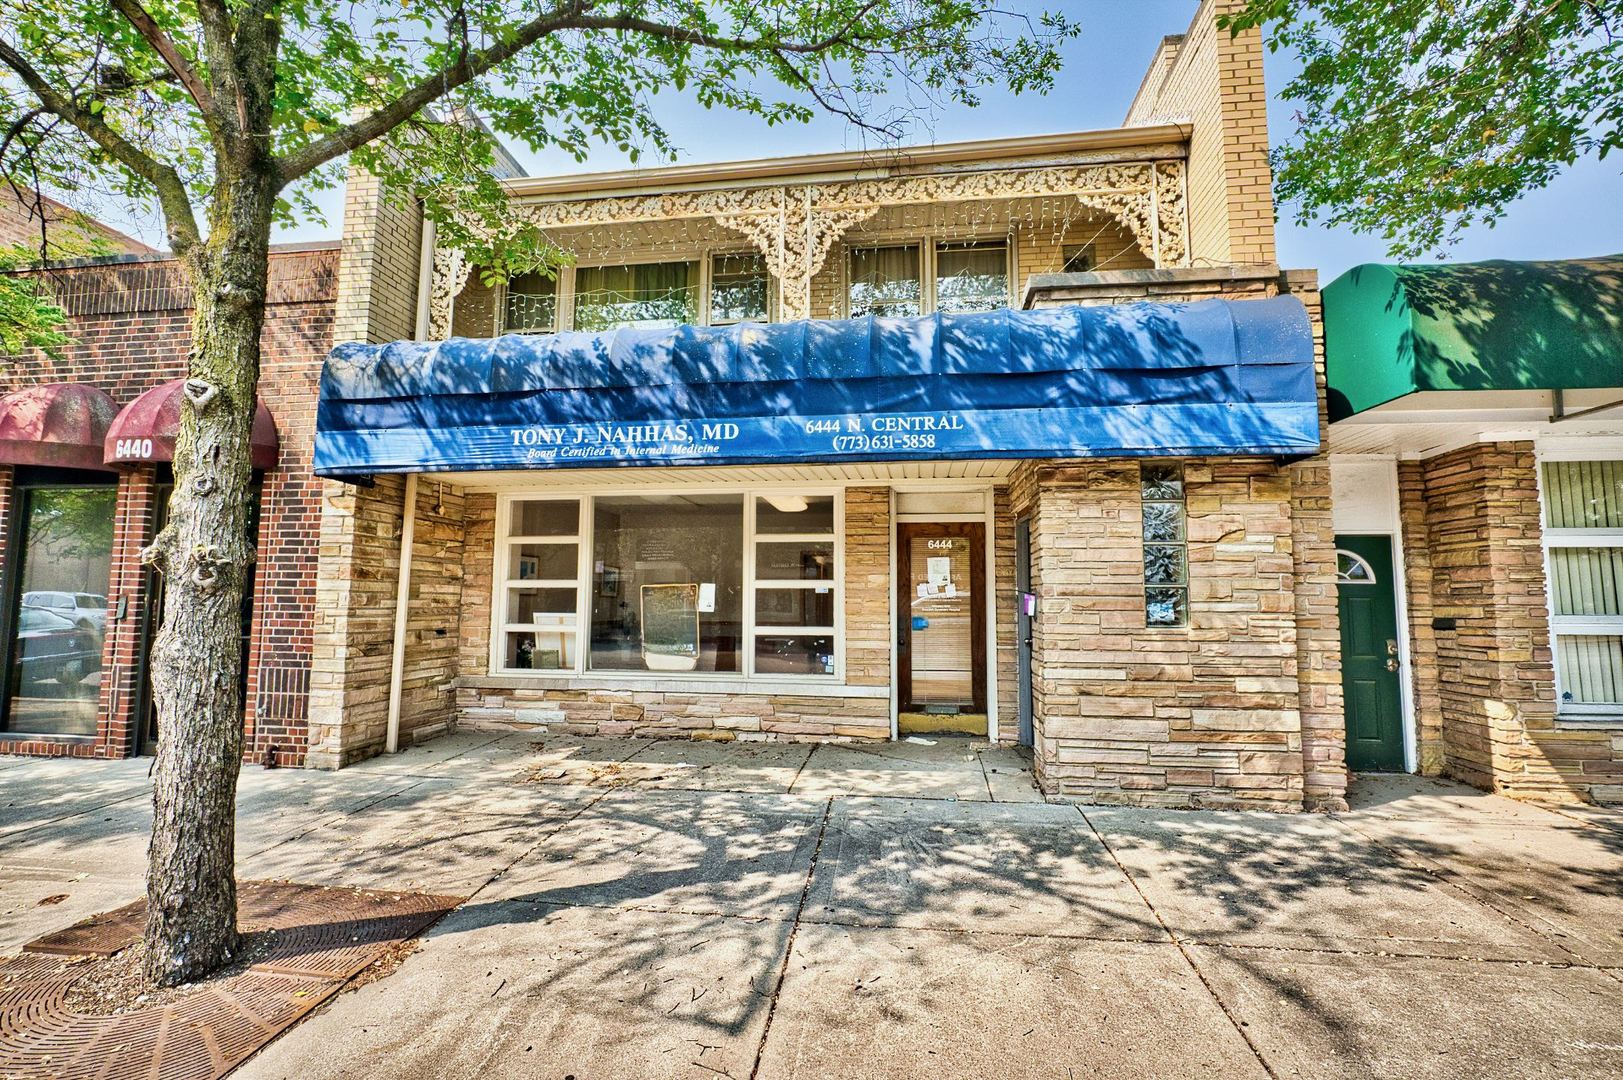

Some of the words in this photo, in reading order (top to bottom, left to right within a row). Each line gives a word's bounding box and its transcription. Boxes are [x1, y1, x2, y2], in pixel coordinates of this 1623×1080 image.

[806, 419, 840, 434] 6444
[847, 418, 865, 433] N.
[872, 415, 964, 432] CENTRAL
[510, 428, 566, 446] TONY
[573, 428, 589, 445] J.
[598, 424, 693, 444] NAHHAS,
[702, 423, 739, 441] MD
[115, 439, 153, 459] 6440
[528, 448, 557, 459] Board
[561, 446, 606, 458] Certified
[625, 445, 666, 456] Internal
[670, 444, 720, 455] Medicine
[927, 539, 953, 550] 6444
